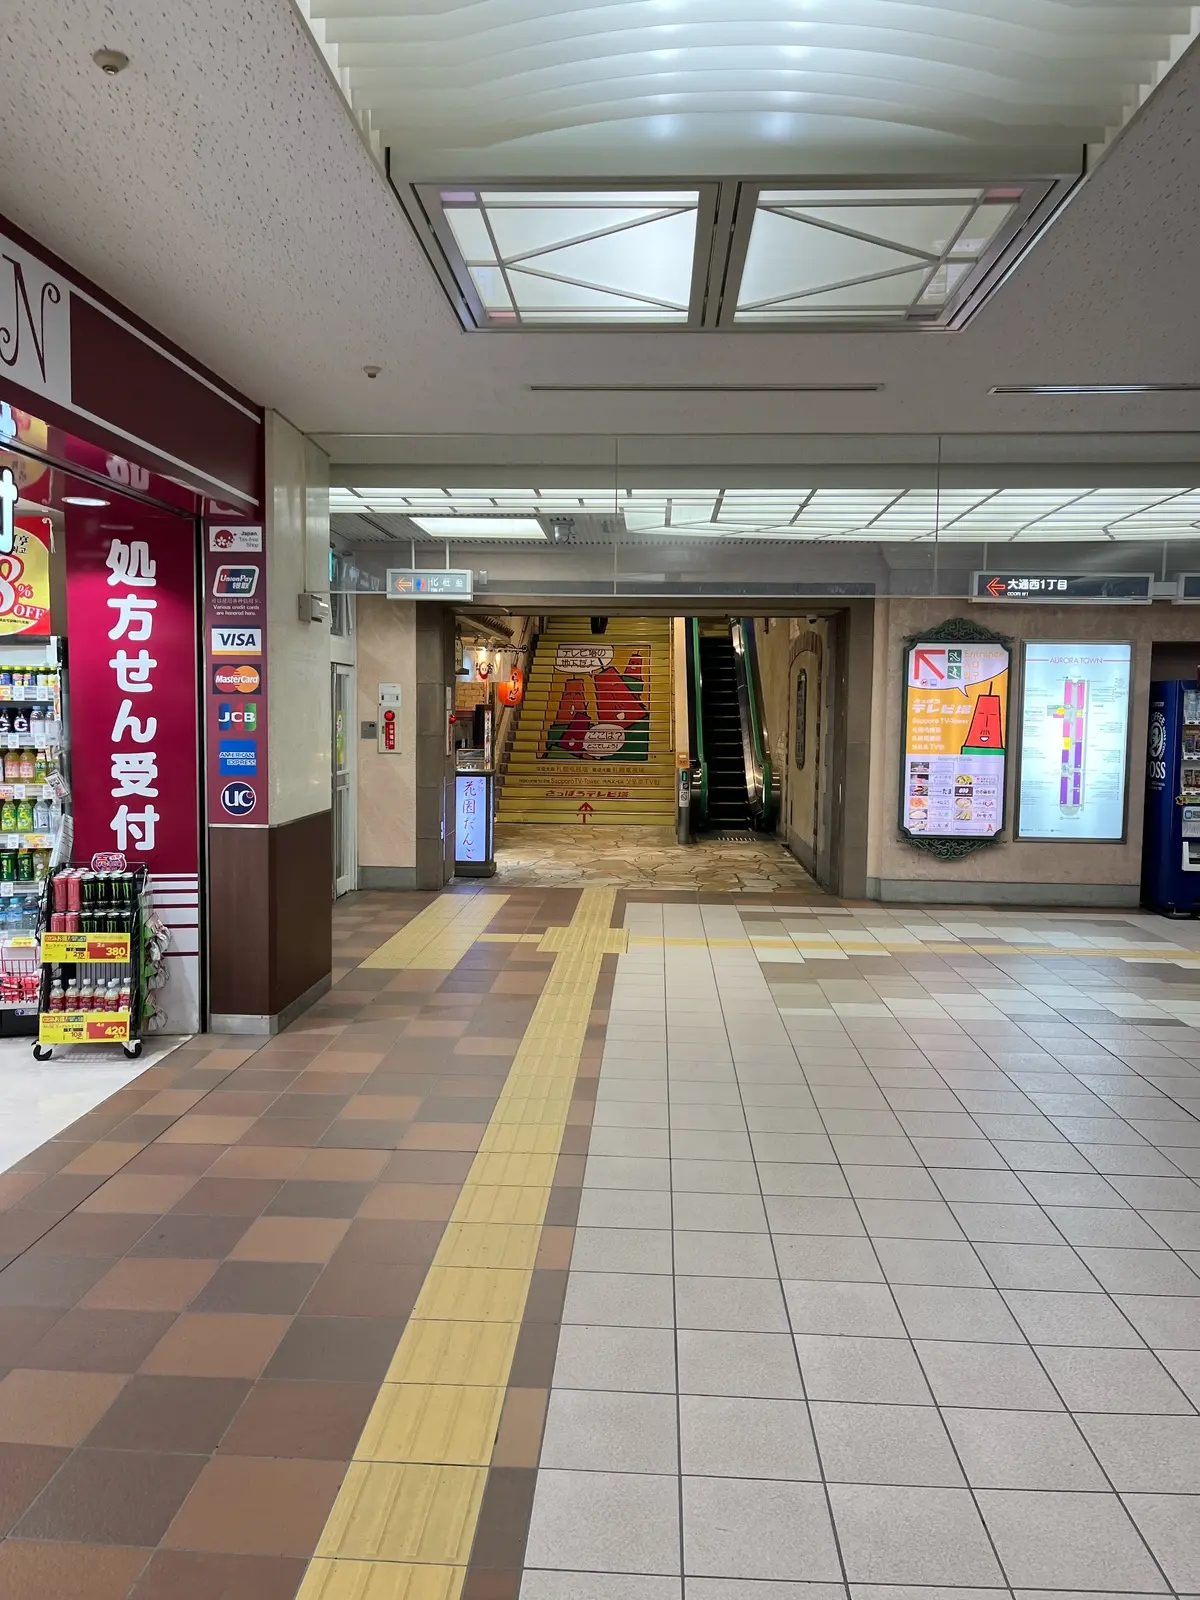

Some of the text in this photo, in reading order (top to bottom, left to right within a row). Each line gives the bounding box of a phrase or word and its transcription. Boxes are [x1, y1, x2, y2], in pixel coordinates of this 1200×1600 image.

[220, 574, 253, 584] UnionPay
[1007, 578, 1068, 590] 大通西1丁目
[14, 604, 45, 620] OFF
[217, 633, 256, 646] VISA
[562, 650, 607, 658] テレビ塔の
[561, 659, 595, 668] 地下だよ
[215, 675, 260, 684] MasterCard
[106, 538, 160, 851] 処方せん受付
[912, 704, 972, 714] テレビ塔
[218, 712, 256, 723] JCB
[1147, 761, 1166, 779] OSS
[551, 778, 574, 786] Sapporo
[224, 790, 254, 807] UC
[545, 790, 629, 798] さっぽろテレビ塔
[462, 781, 477, 859] 花園だんご
[105, 947, 126, 956] 380
[104, 1026, 126, 1035] 420
